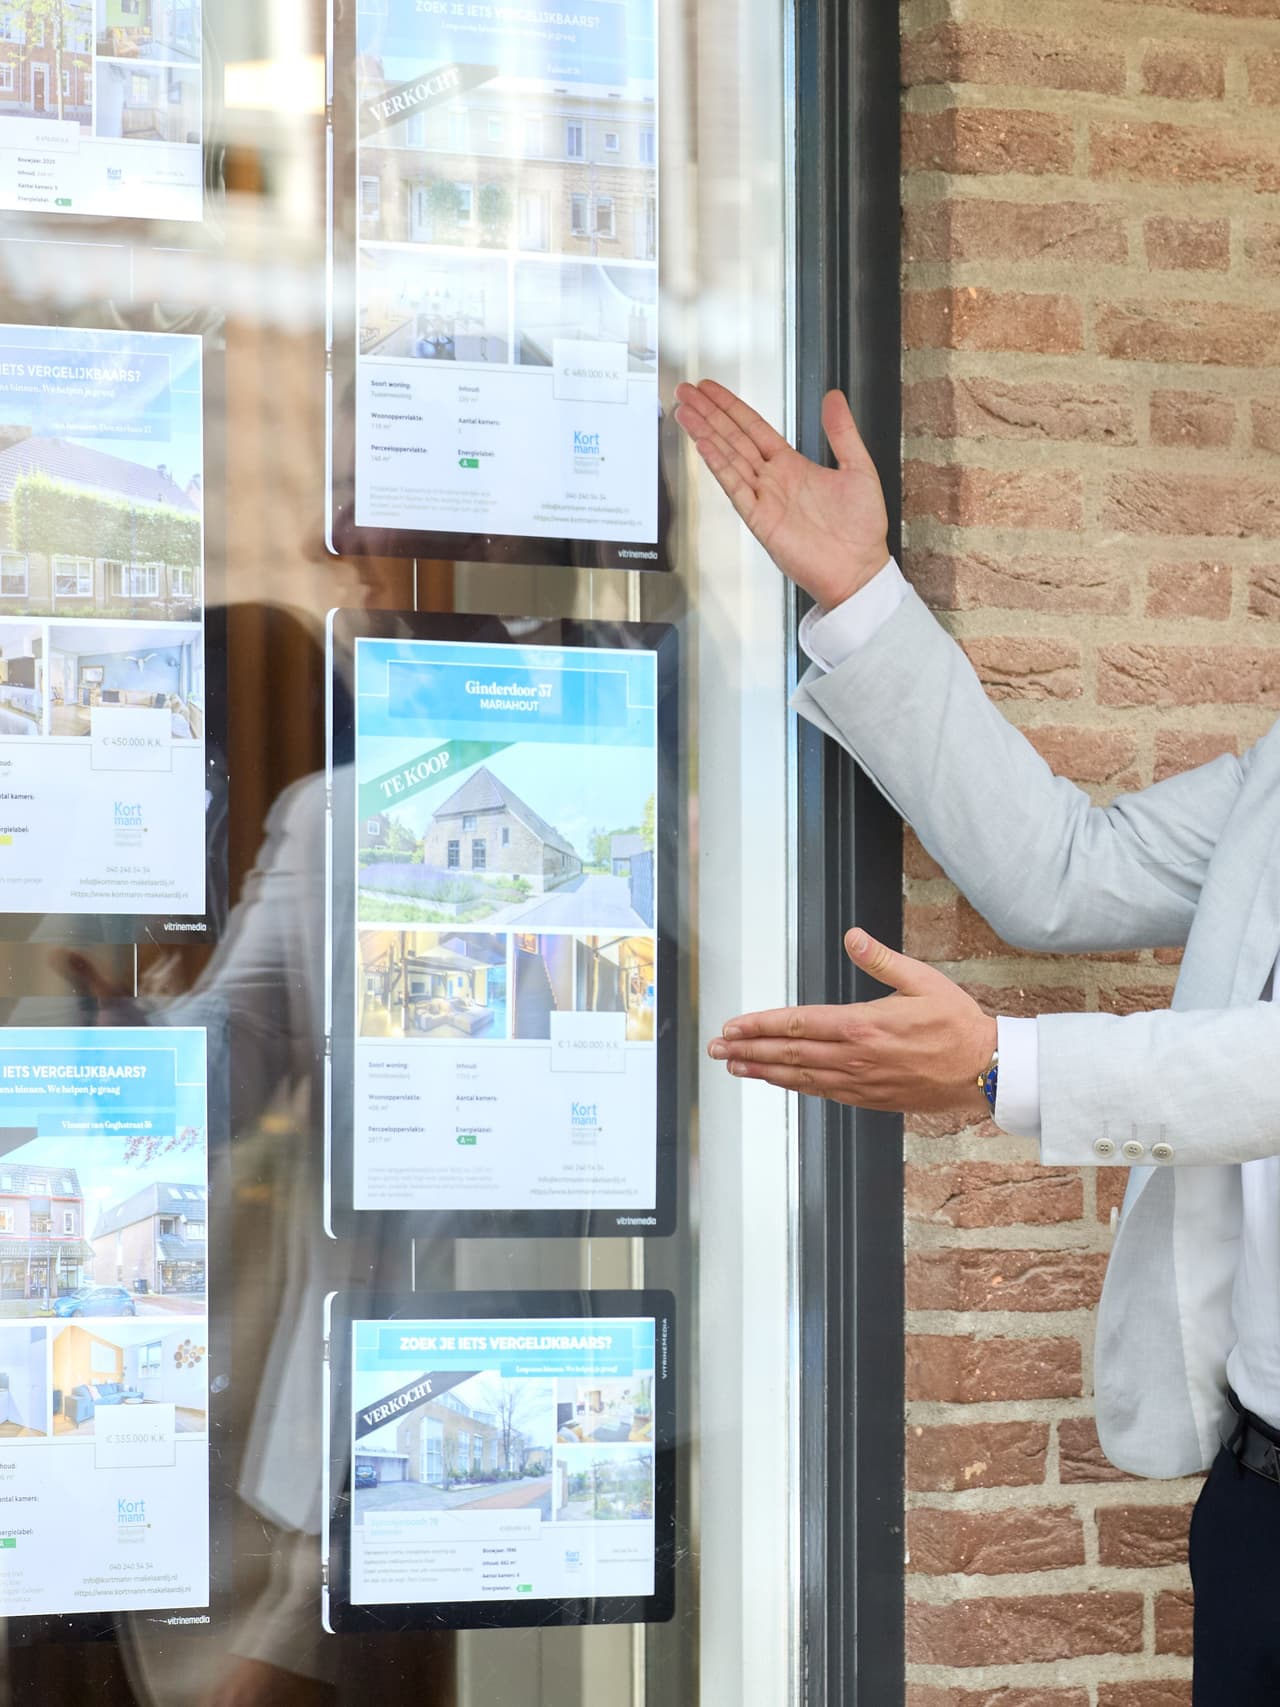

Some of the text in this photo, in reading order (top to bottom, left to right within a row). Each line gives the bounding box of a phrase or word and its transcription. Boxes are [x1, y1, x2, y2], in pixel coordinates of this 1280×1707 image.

[369, 68, 460, 121] VERKOCHT
[27, 364, 142, 383] VERGELIJKBAARS?
[574, 431, 600, 446] Kort
[617, 549, 658, 560] vitrinemedia
[464, 680, 538, 697] Ginderdoor
[480, 699, 540, 711] MARIAHOUT
[380, 751, 451, 799] TE KOOP
[114, 801, 143, 816] Kort
[114, 816, 143, 826] mann
[163, 922, 207, 932] vitrinemedia
[3, 1065, 147, 1079] IETS VERGELIJKBAARS?
[571, 1102, 597, 1116] Kort
[616, 1216, 657, 1226] vitrinemedia
[400, 1336, 613, 1350] ZOEK JE IETS VERGELIJKBAARS?
[363, 1379, 434, 1427] VERKOCHT
[118, 1499, 145, 1513] Kort
[118, 1512, 145, 1523] mann
[167, 1615, 210, 1625] vitrinemedia
